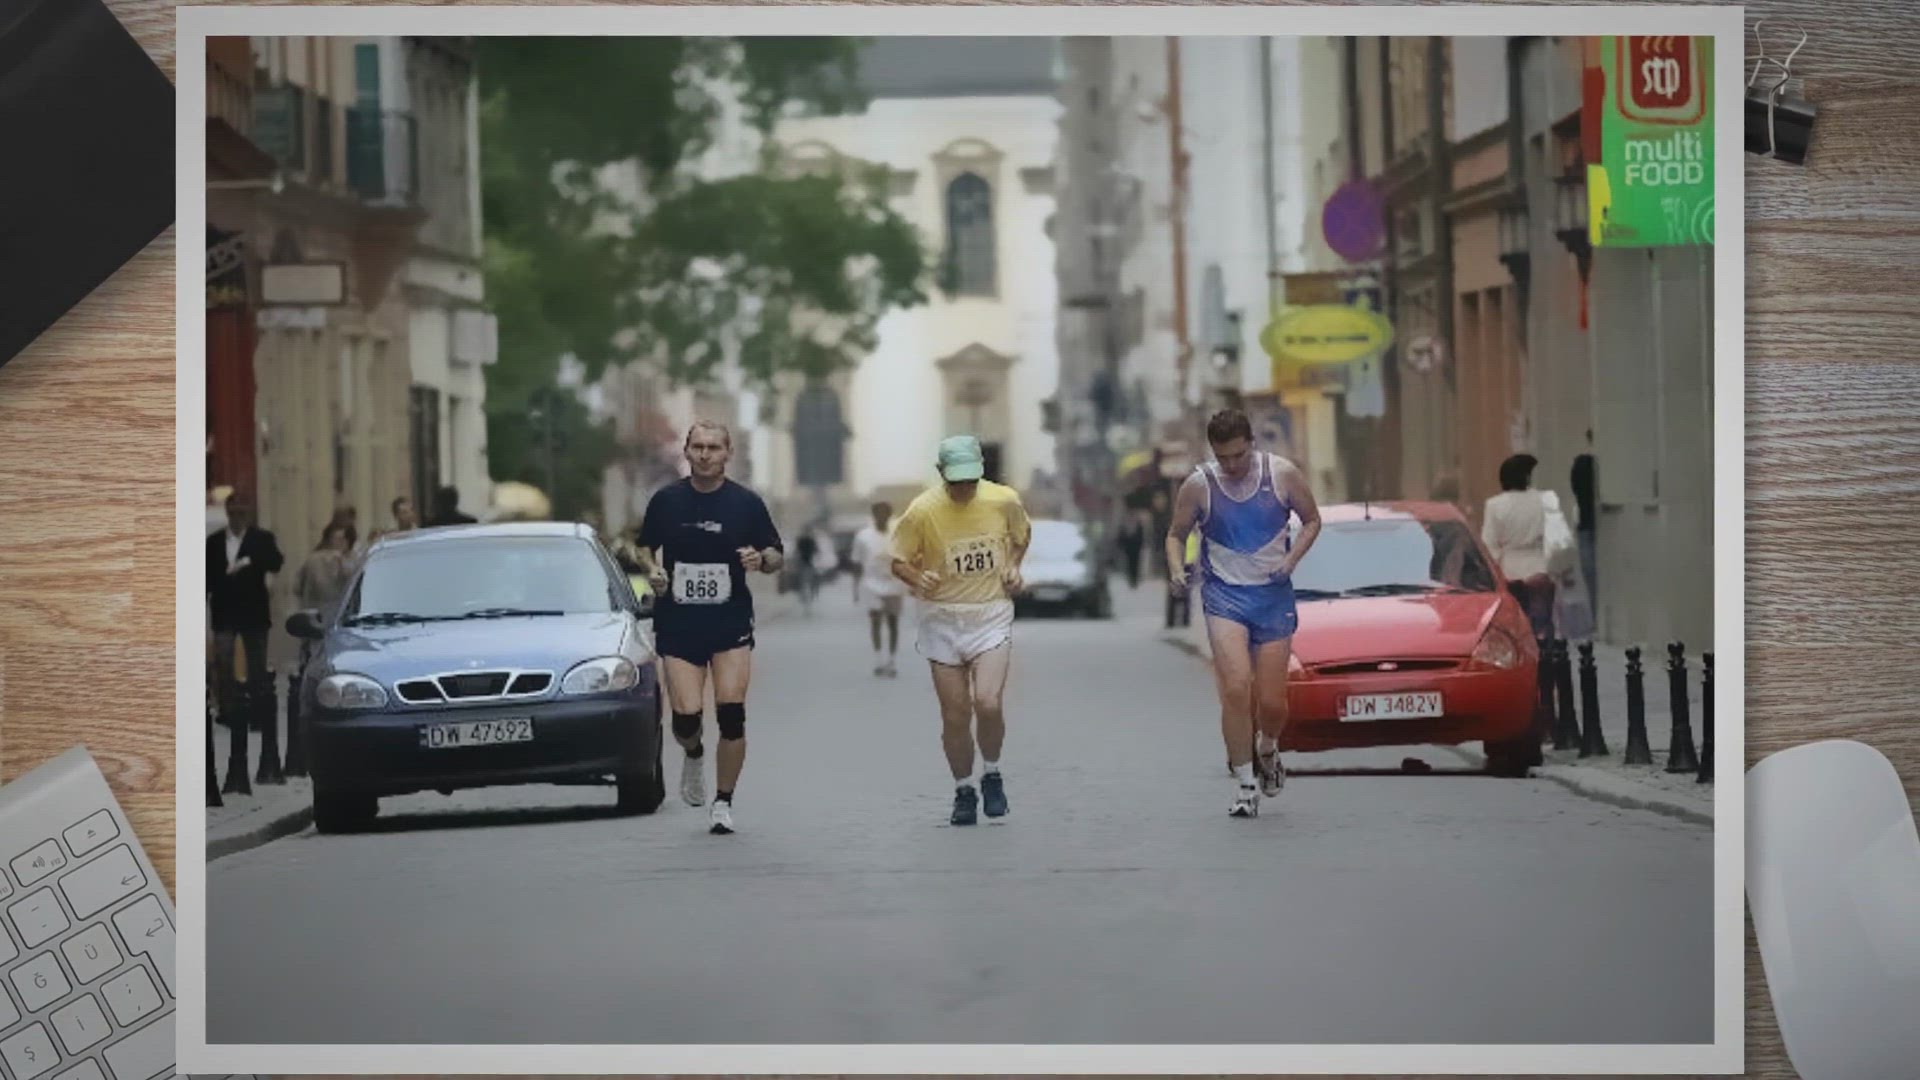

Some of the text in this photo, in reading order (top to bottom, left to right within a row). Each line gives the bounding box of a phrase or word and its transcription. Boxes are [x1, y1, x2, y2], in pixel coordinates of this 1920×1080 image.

[1641, 56, 1680, 99] stp
[1625, 131, 1702, 162] multi
[1625, 162, 1704, 186] FOOD
[954, 550, 994, 573] 1281
[686, 579, 718, 598] 868
[1351, 695, 1437, 715] DW 3482V
[430, 721, 530, 746] DW 47692
[84, 943, 98, 960] Ü
